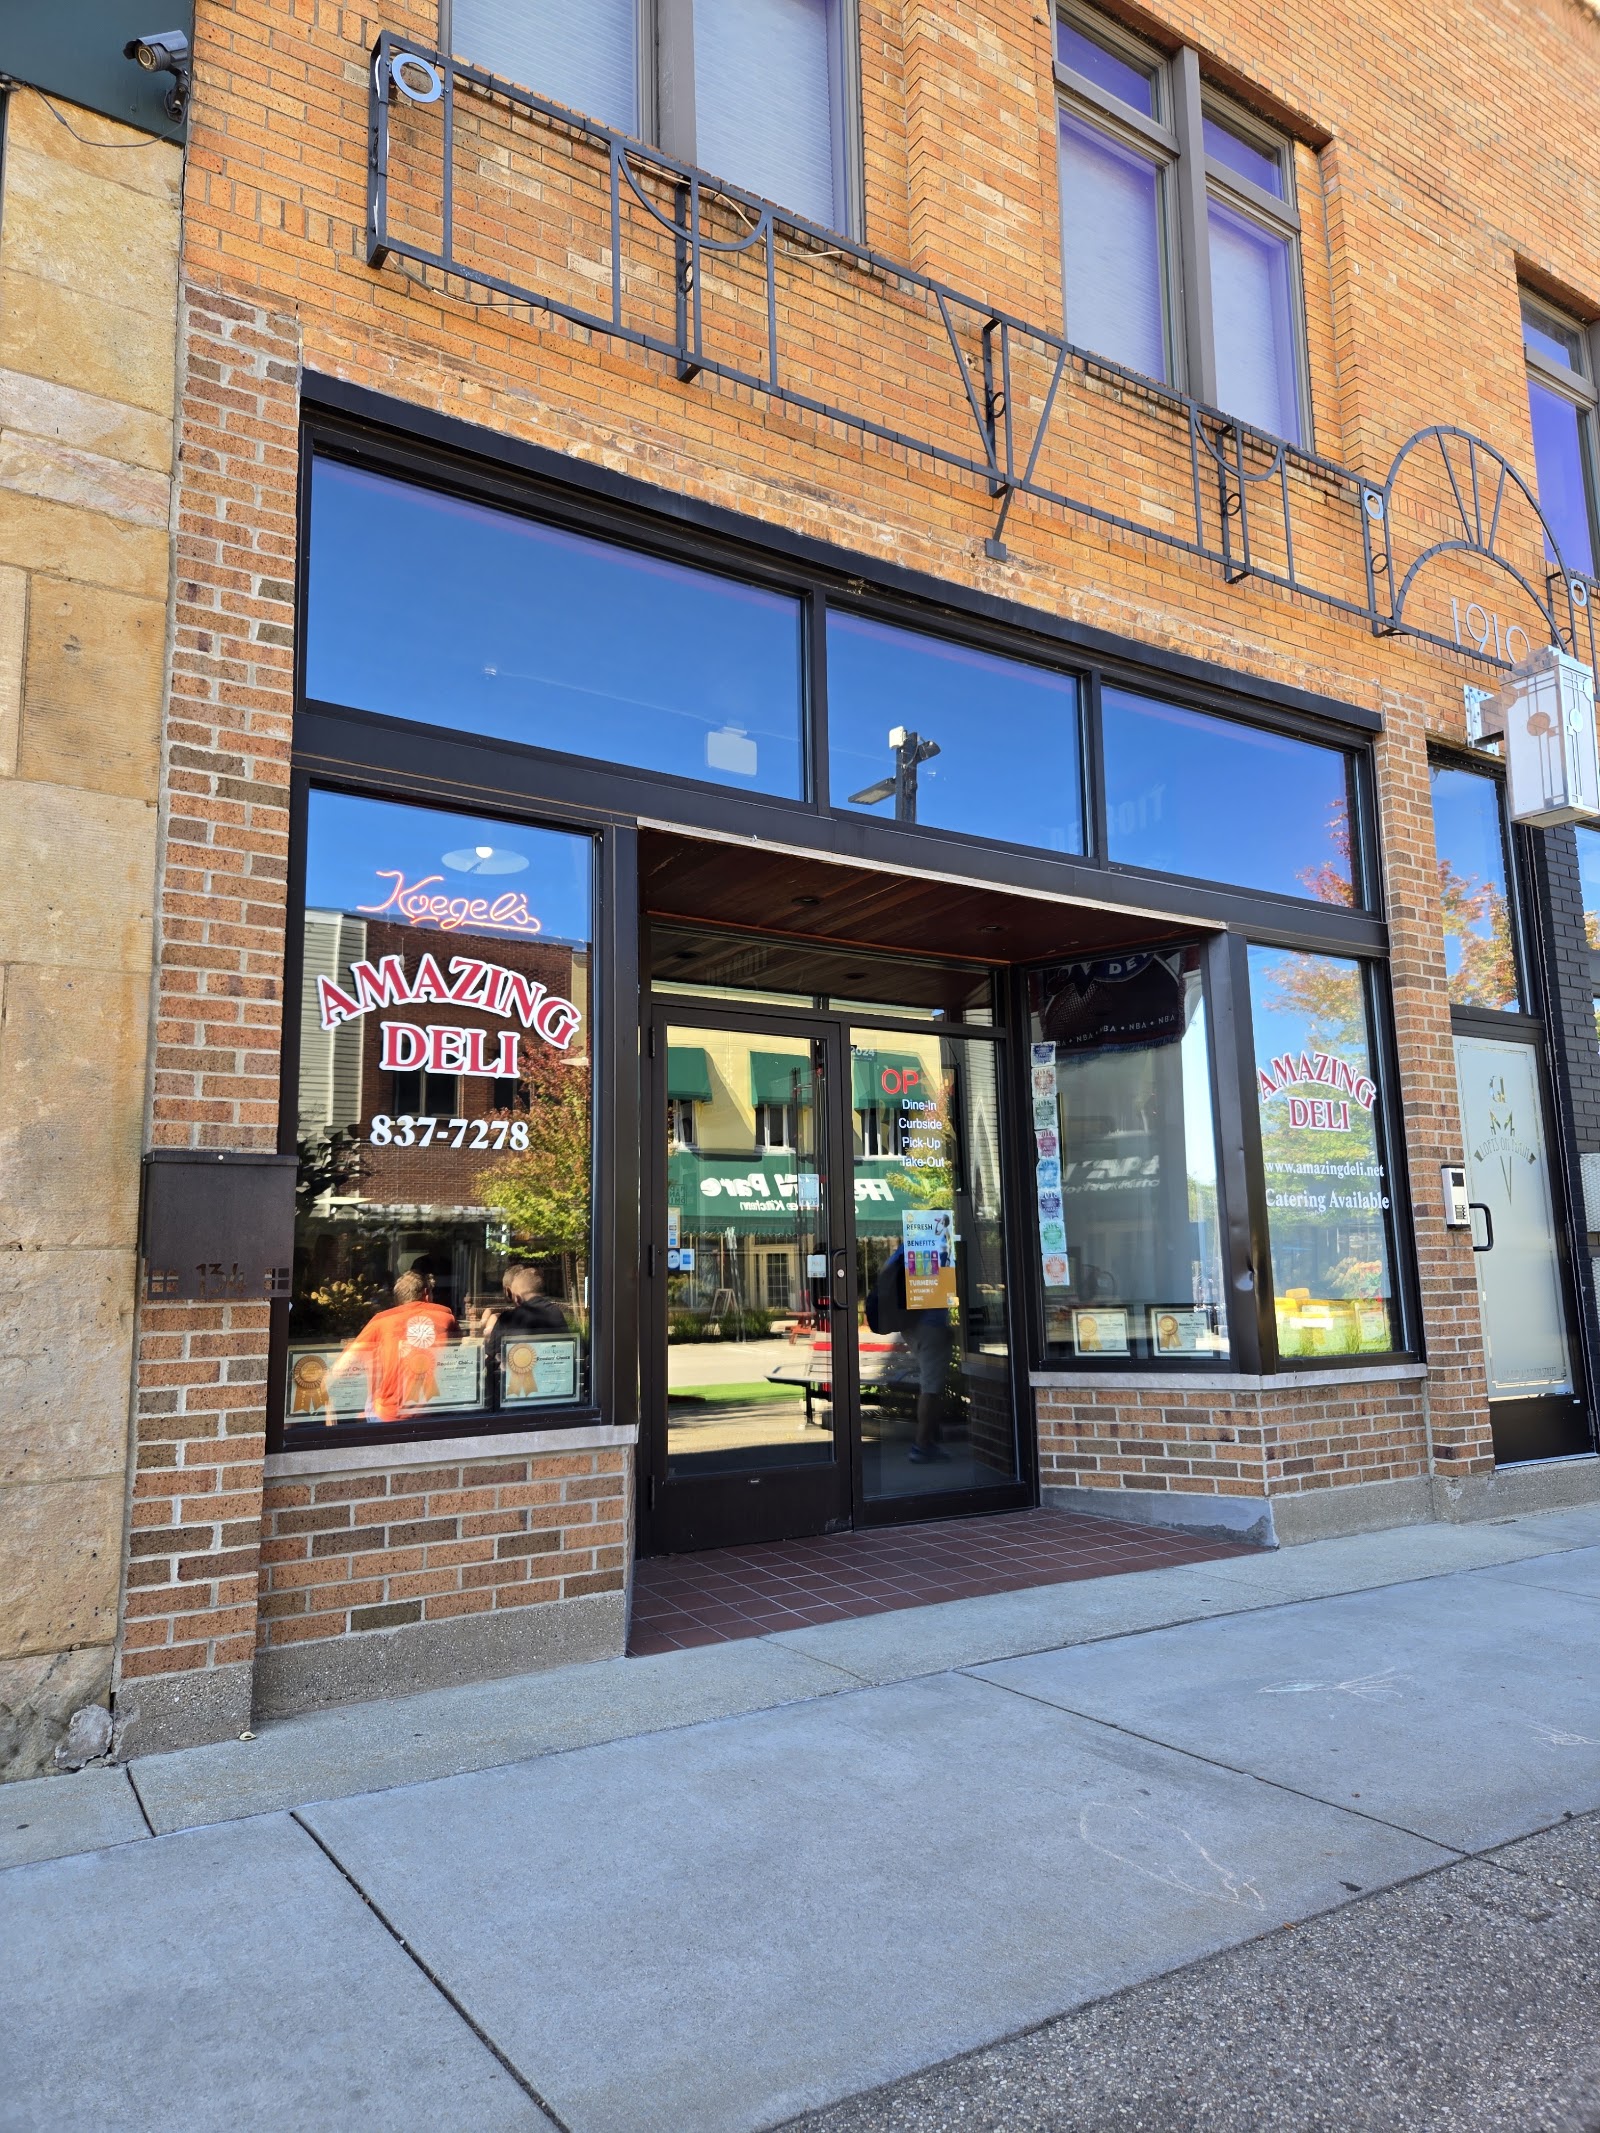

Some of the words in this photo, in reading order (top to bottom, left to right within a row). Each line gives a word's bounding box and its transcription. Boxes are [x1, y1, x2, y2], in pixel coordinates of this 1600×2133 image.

[1451, 597, 1531, 664] 1910
[357, 870, 541, 933] Koegel's
[317, 953, 582, 1049] AMAZING
[1129, 1022, 1147, 1031] NBA
[1158, 1014, 1175, 1024] NBA
[379, 1021, 521, 1079] DELI
[1257, 1050, 1377, 1111] AMAZING
[902, 1098, 937, 1110] Dine-In
[1288, 1097, 1352, 1132] DELI
[369, 1114, 530, 1151] 837-7278
[898, 1117, 942, 1129] Curbside
[902, 1136, 941, 1150] Pick-Up
[901, 1156, 944, 1167] Take-Out
[1264, 1161, 1385, 1179] www.amazingdeli.net
[1265, 1188, 1327, 1212] Catering
[1329, 1190, 1390, 1209] Available
[906, 1223, 933, 1231] REFRESH
[909, 1279, 939, 1287] TURMERIC
